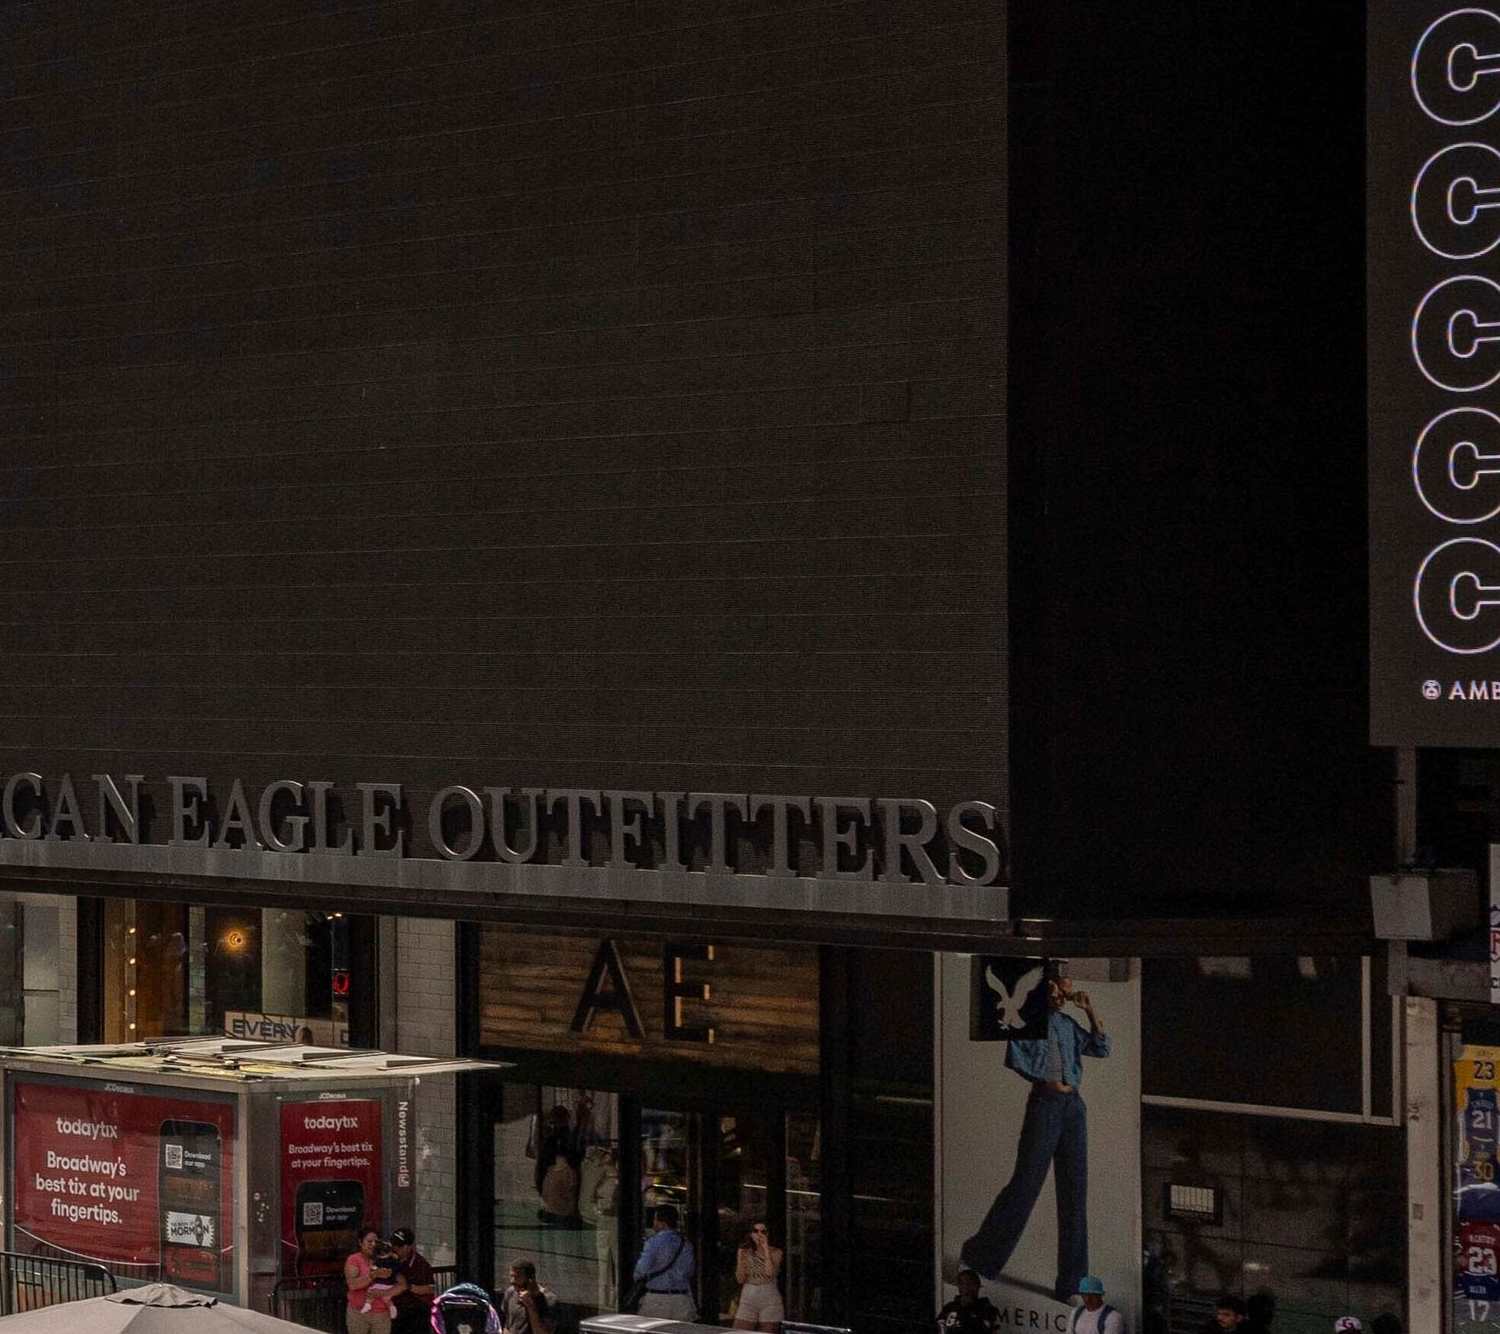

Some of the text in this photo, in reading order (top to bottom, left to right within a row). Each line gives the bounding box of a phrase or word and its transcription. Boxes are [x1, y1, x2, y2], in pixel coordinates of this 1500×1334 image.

[168, 777, 405, 858] EAGLE
[428, 785, 1000, 887] OUTFITTERS
[571, 937, 715, 1043] AE
[232, 1018, 300, 1039] EVERY
[1474, 1061, 1495, 1079] 23
[56, 1117, 117, 1139] todaytix
[304, 1115, 358, 1130] todaytix
[1472, 1111, 1492, 1129] 21
[288, 1142, 373, 1155] Broadway's best tix
[399, 1101, 409, 1173] Newsstand
[47, 1151, 127, 1177] Broadway's
[302, 1157, 321, 1169] your
[324, 1155, 370, 1169] fingertips.
[36, 1174, 139, 1203] best tix at your
[51, 1198, 122, 1225] fingertips.
[1468, 1248, 1495, 1276] 23
